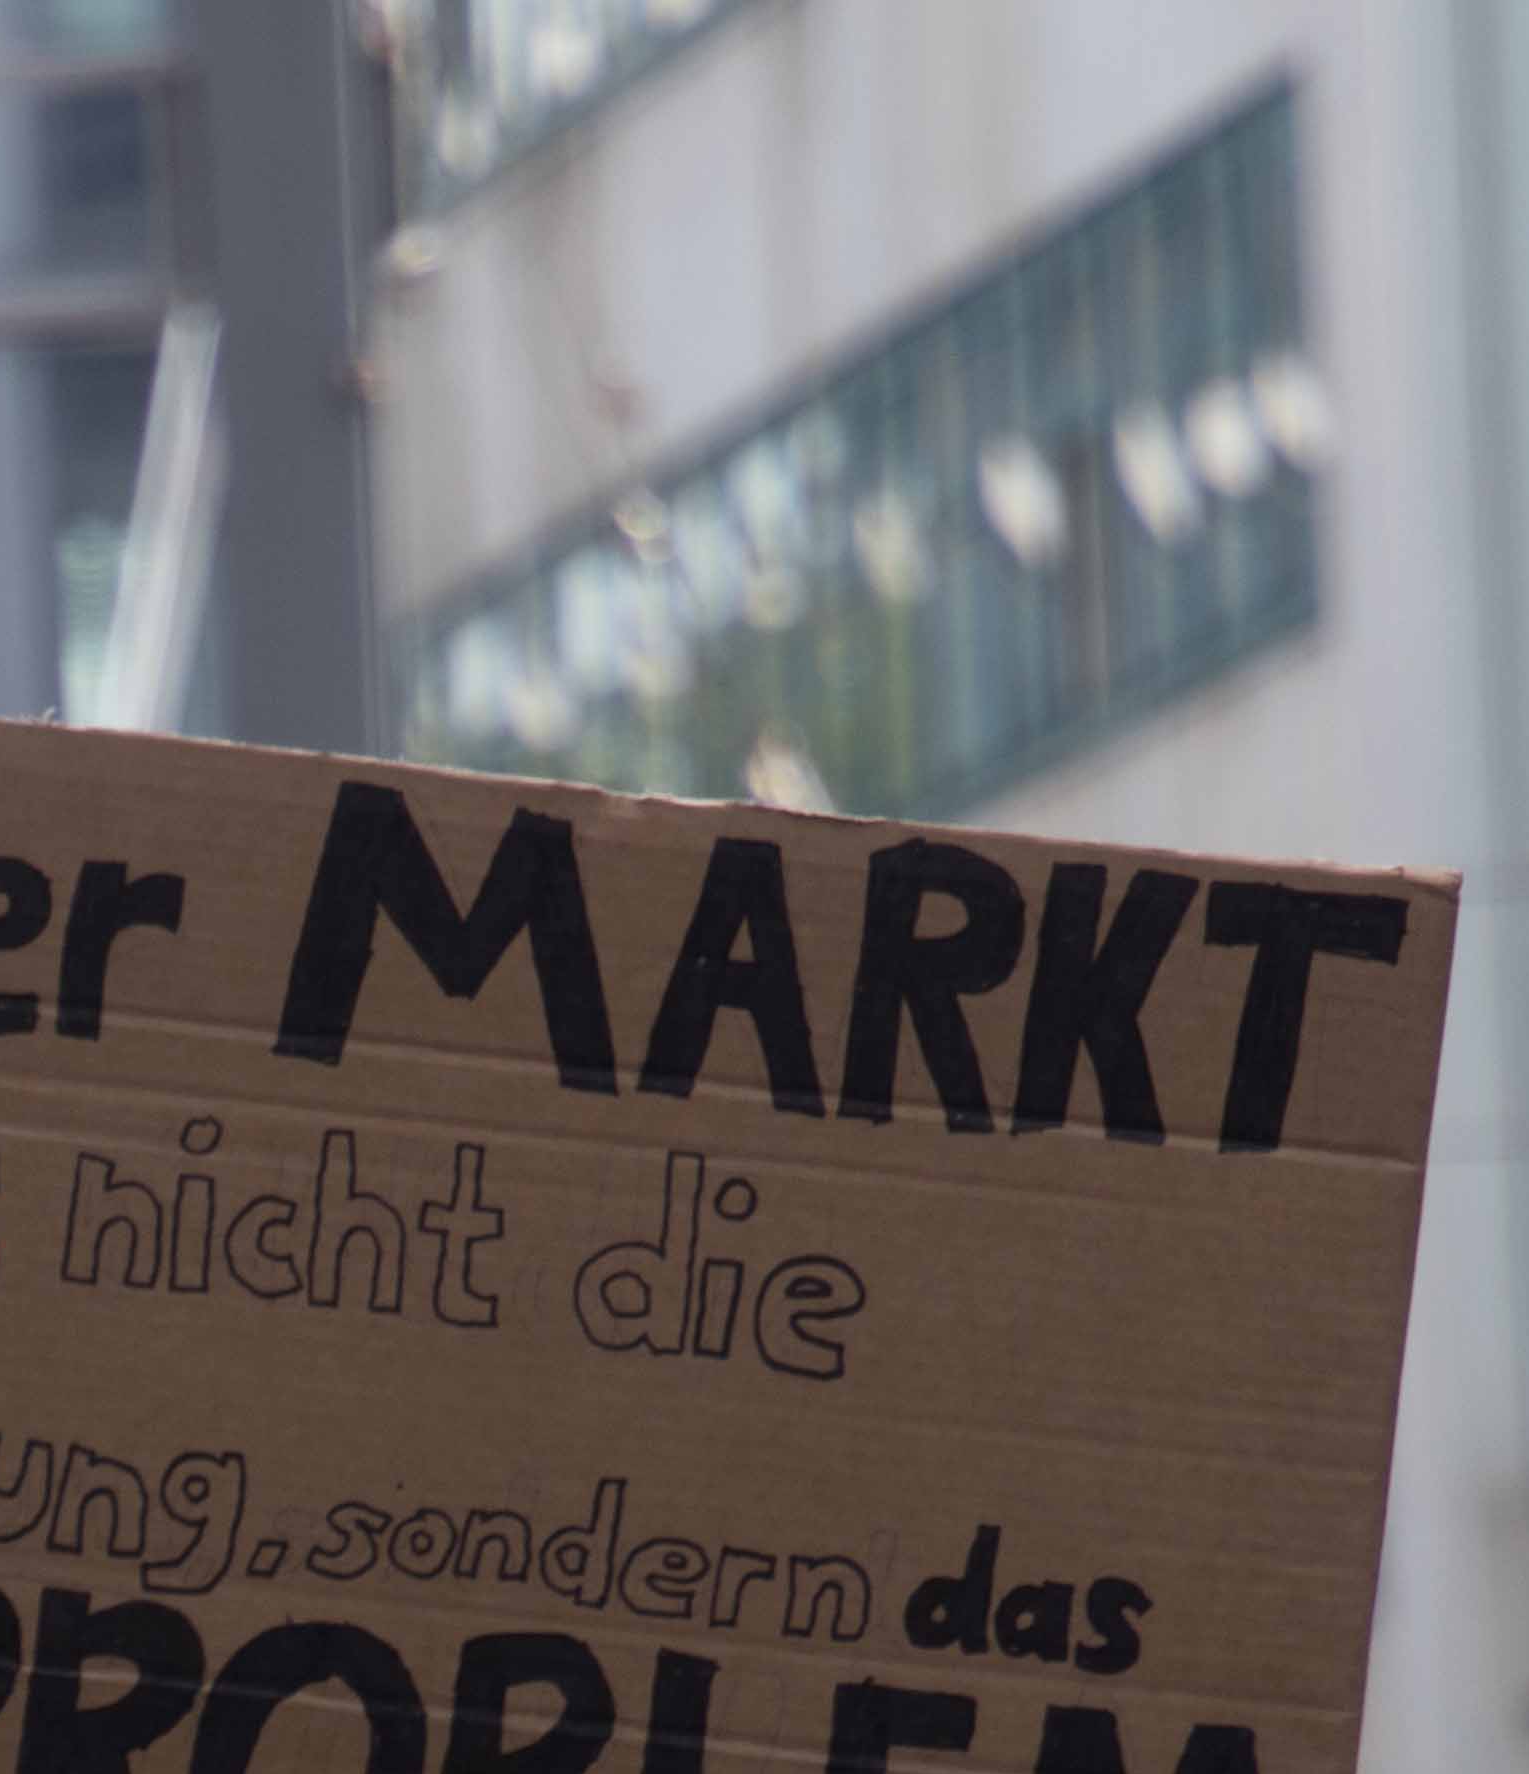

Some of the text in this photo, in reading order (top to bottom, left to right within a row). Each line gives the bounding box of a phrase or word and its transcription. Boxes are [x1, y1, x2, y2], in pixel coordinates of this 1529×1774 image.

[271, 780, 1410, 1152] MARKT
[61, 1117, 506, 1328] nicht
[573, 1152, 867, 1379] die
[305, 1478, 872, 1642] sondern
[903, 1523, 1154, 1675] das
